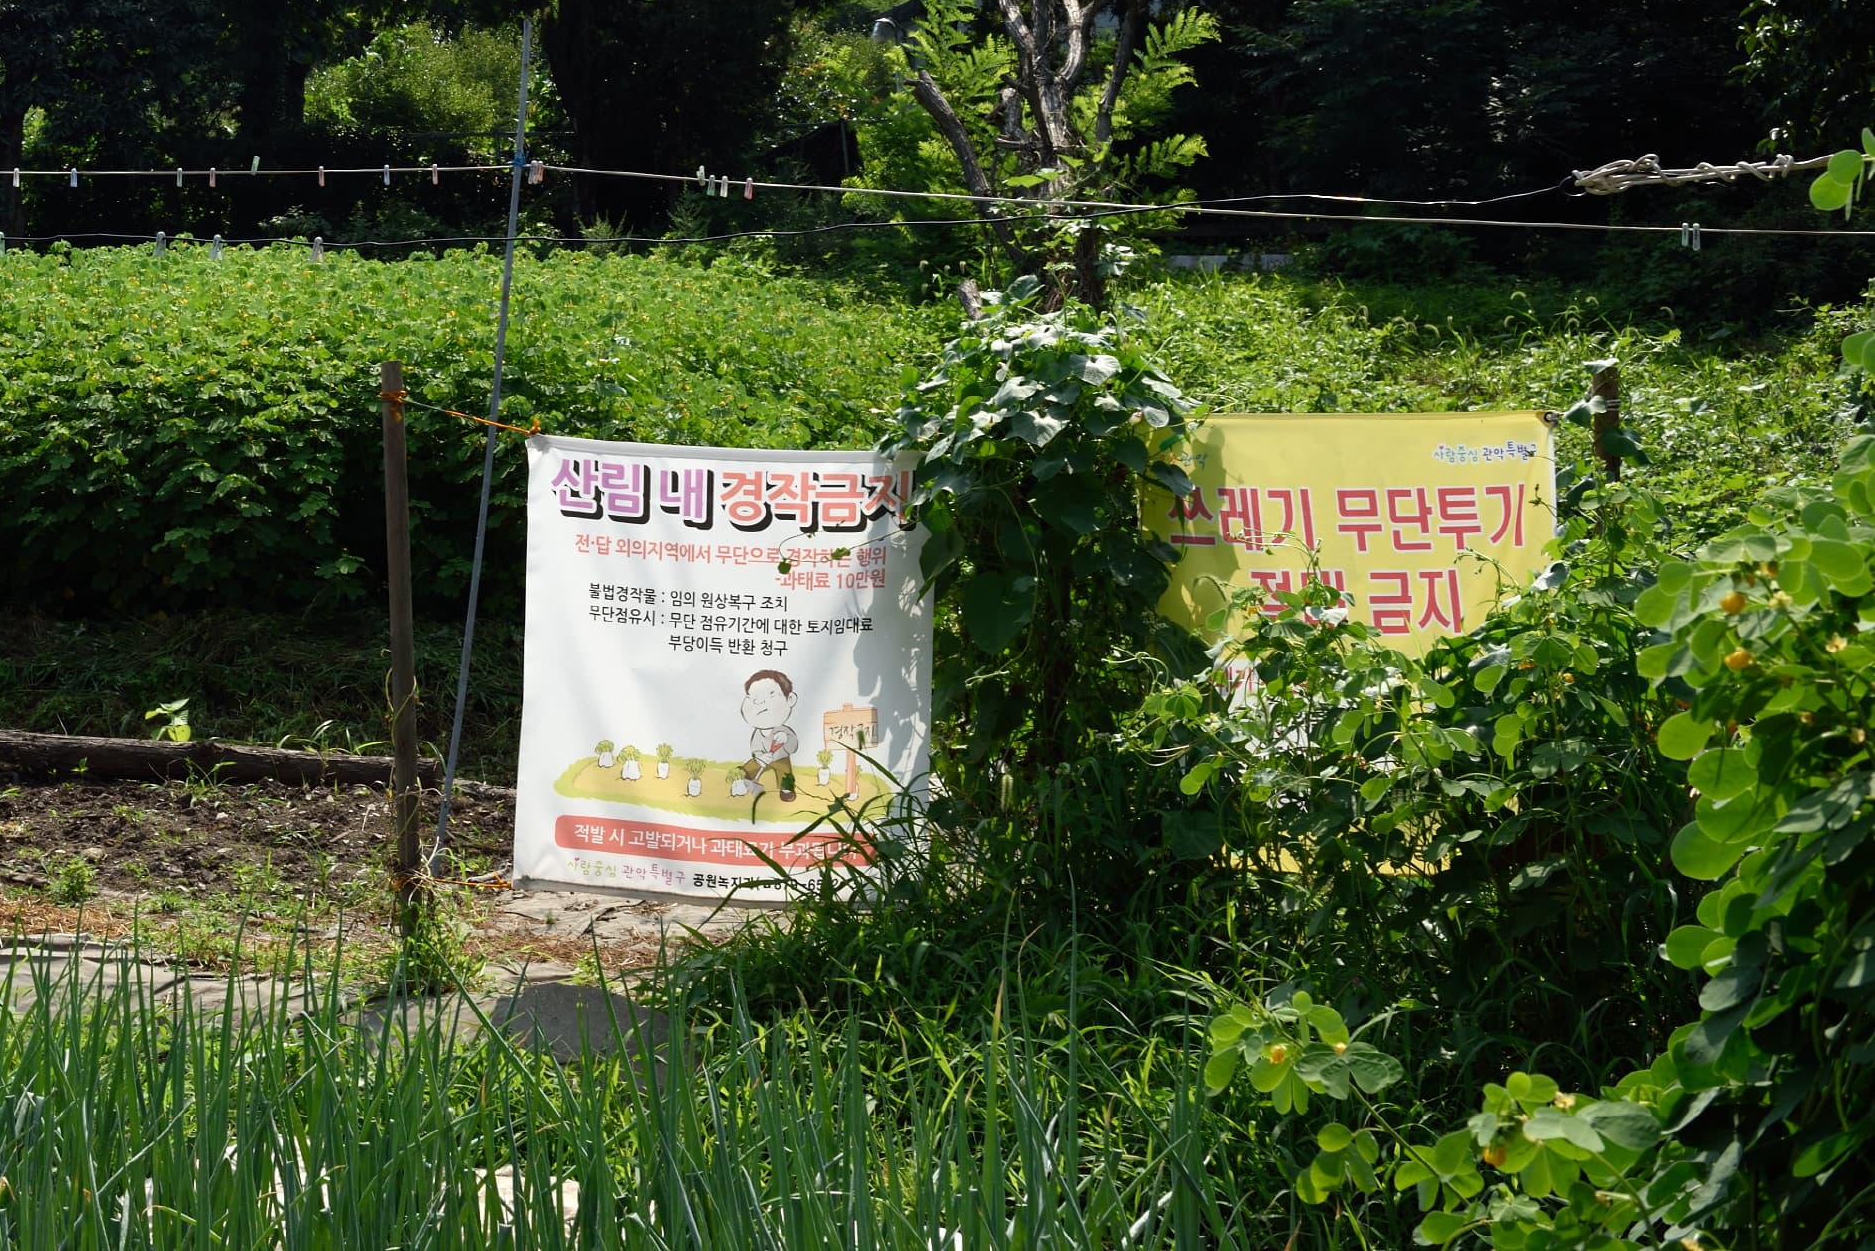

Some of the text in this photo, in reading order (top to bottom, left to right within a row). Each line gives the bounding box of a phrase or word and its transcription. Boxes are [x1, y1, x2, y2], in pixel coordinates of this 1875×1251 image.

[551, 456, 917, 533] 산림 내 경작금지
[1168, 483, 1527, 552] 쓰레기 무단투기
[615, 538, 711, 563] 외의지역에서
[716, 545, 781, 565] 무단으로
[856, 546, 887, 567] 행위
[836, 568, 886, 589] 10만원
[589, 583, 657, 604] 불법경작물
[670, 590, 696, 608] 임의
[700, 592, 756, 610] 원상복구
[760, 596, 788, 612] 조치
[1368, 569, 1463, 635] 금지
[589, 605, 656, 626] 무단점유시
[669, 612, 696, 630] 무단
[700, 614, 770, 635] 점유기간에
[774, 619, 802, 636] 대한
[806, 617, 874, 636] 토지임대료
[669, 635, 788, 657] 부당이득 반환 청구
[574, 824, 606, 845] 적발
[609, 828, 624, 847] 시
[628, 830, 707, 855] 고발되거나
[622, 863, 686, 886] 관악특별구
